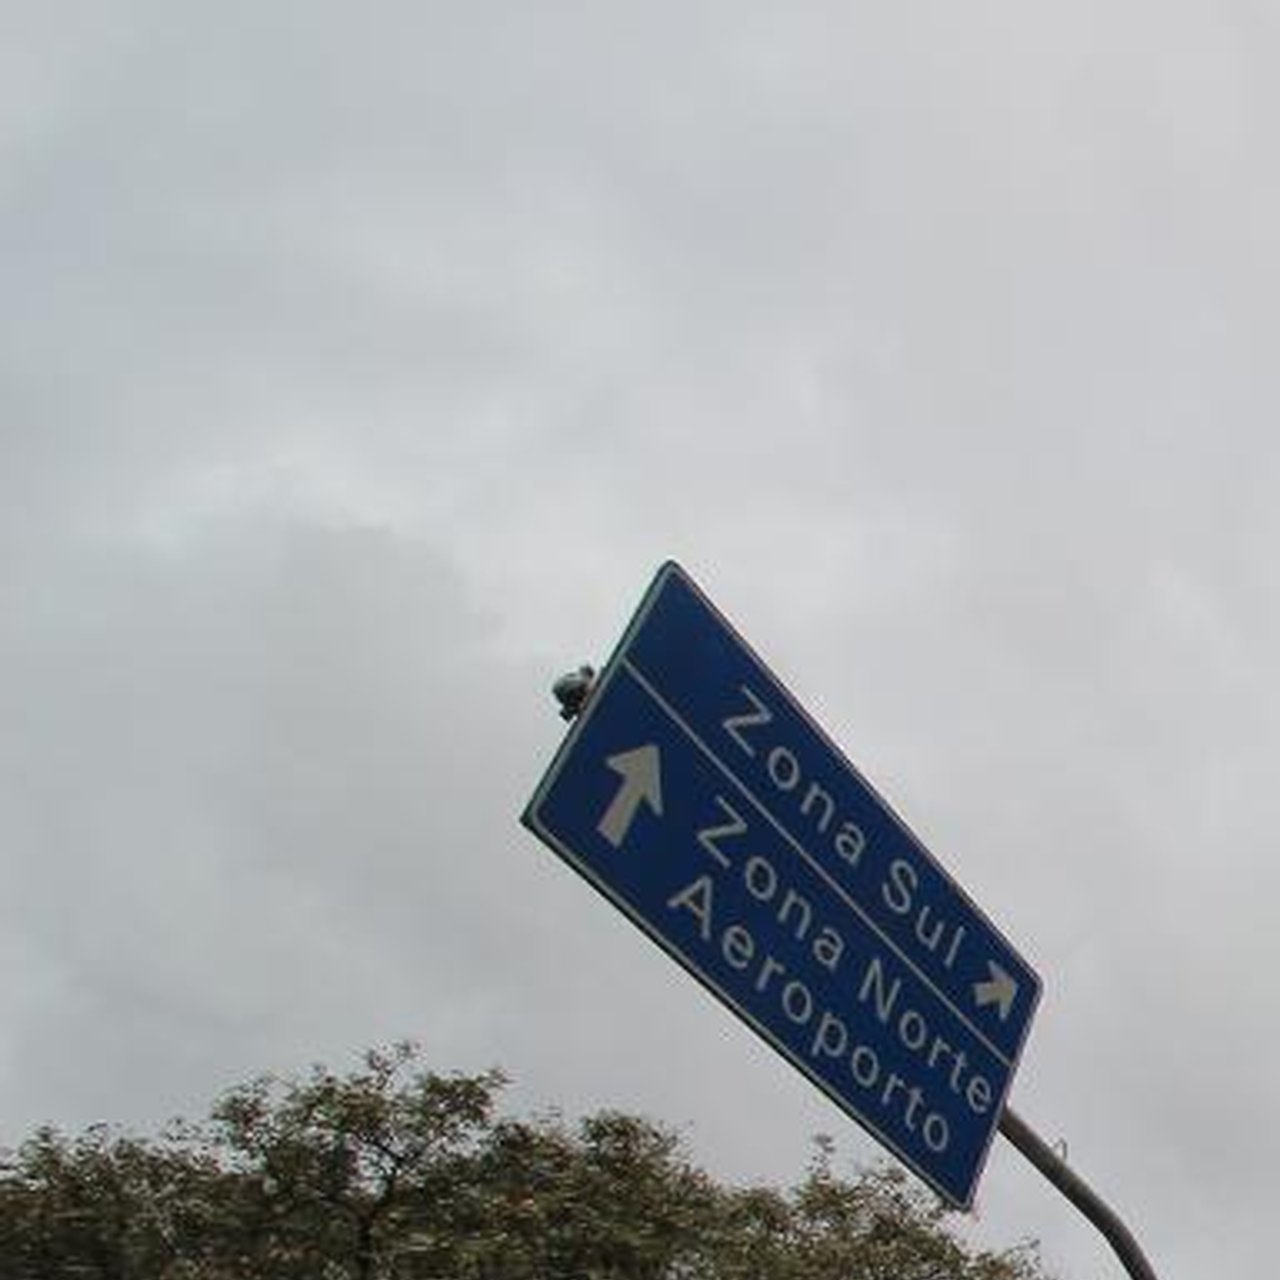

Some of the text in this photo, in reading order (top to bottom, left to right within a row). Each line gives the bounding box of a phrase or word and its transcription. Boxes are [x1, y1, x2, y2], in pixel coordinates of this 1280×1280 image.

[697, 795, 994, 1116] Zona Norte
[722, 684, 969, 969] Zona Sul
[667, 873, 950, 1153] Aeroporto
